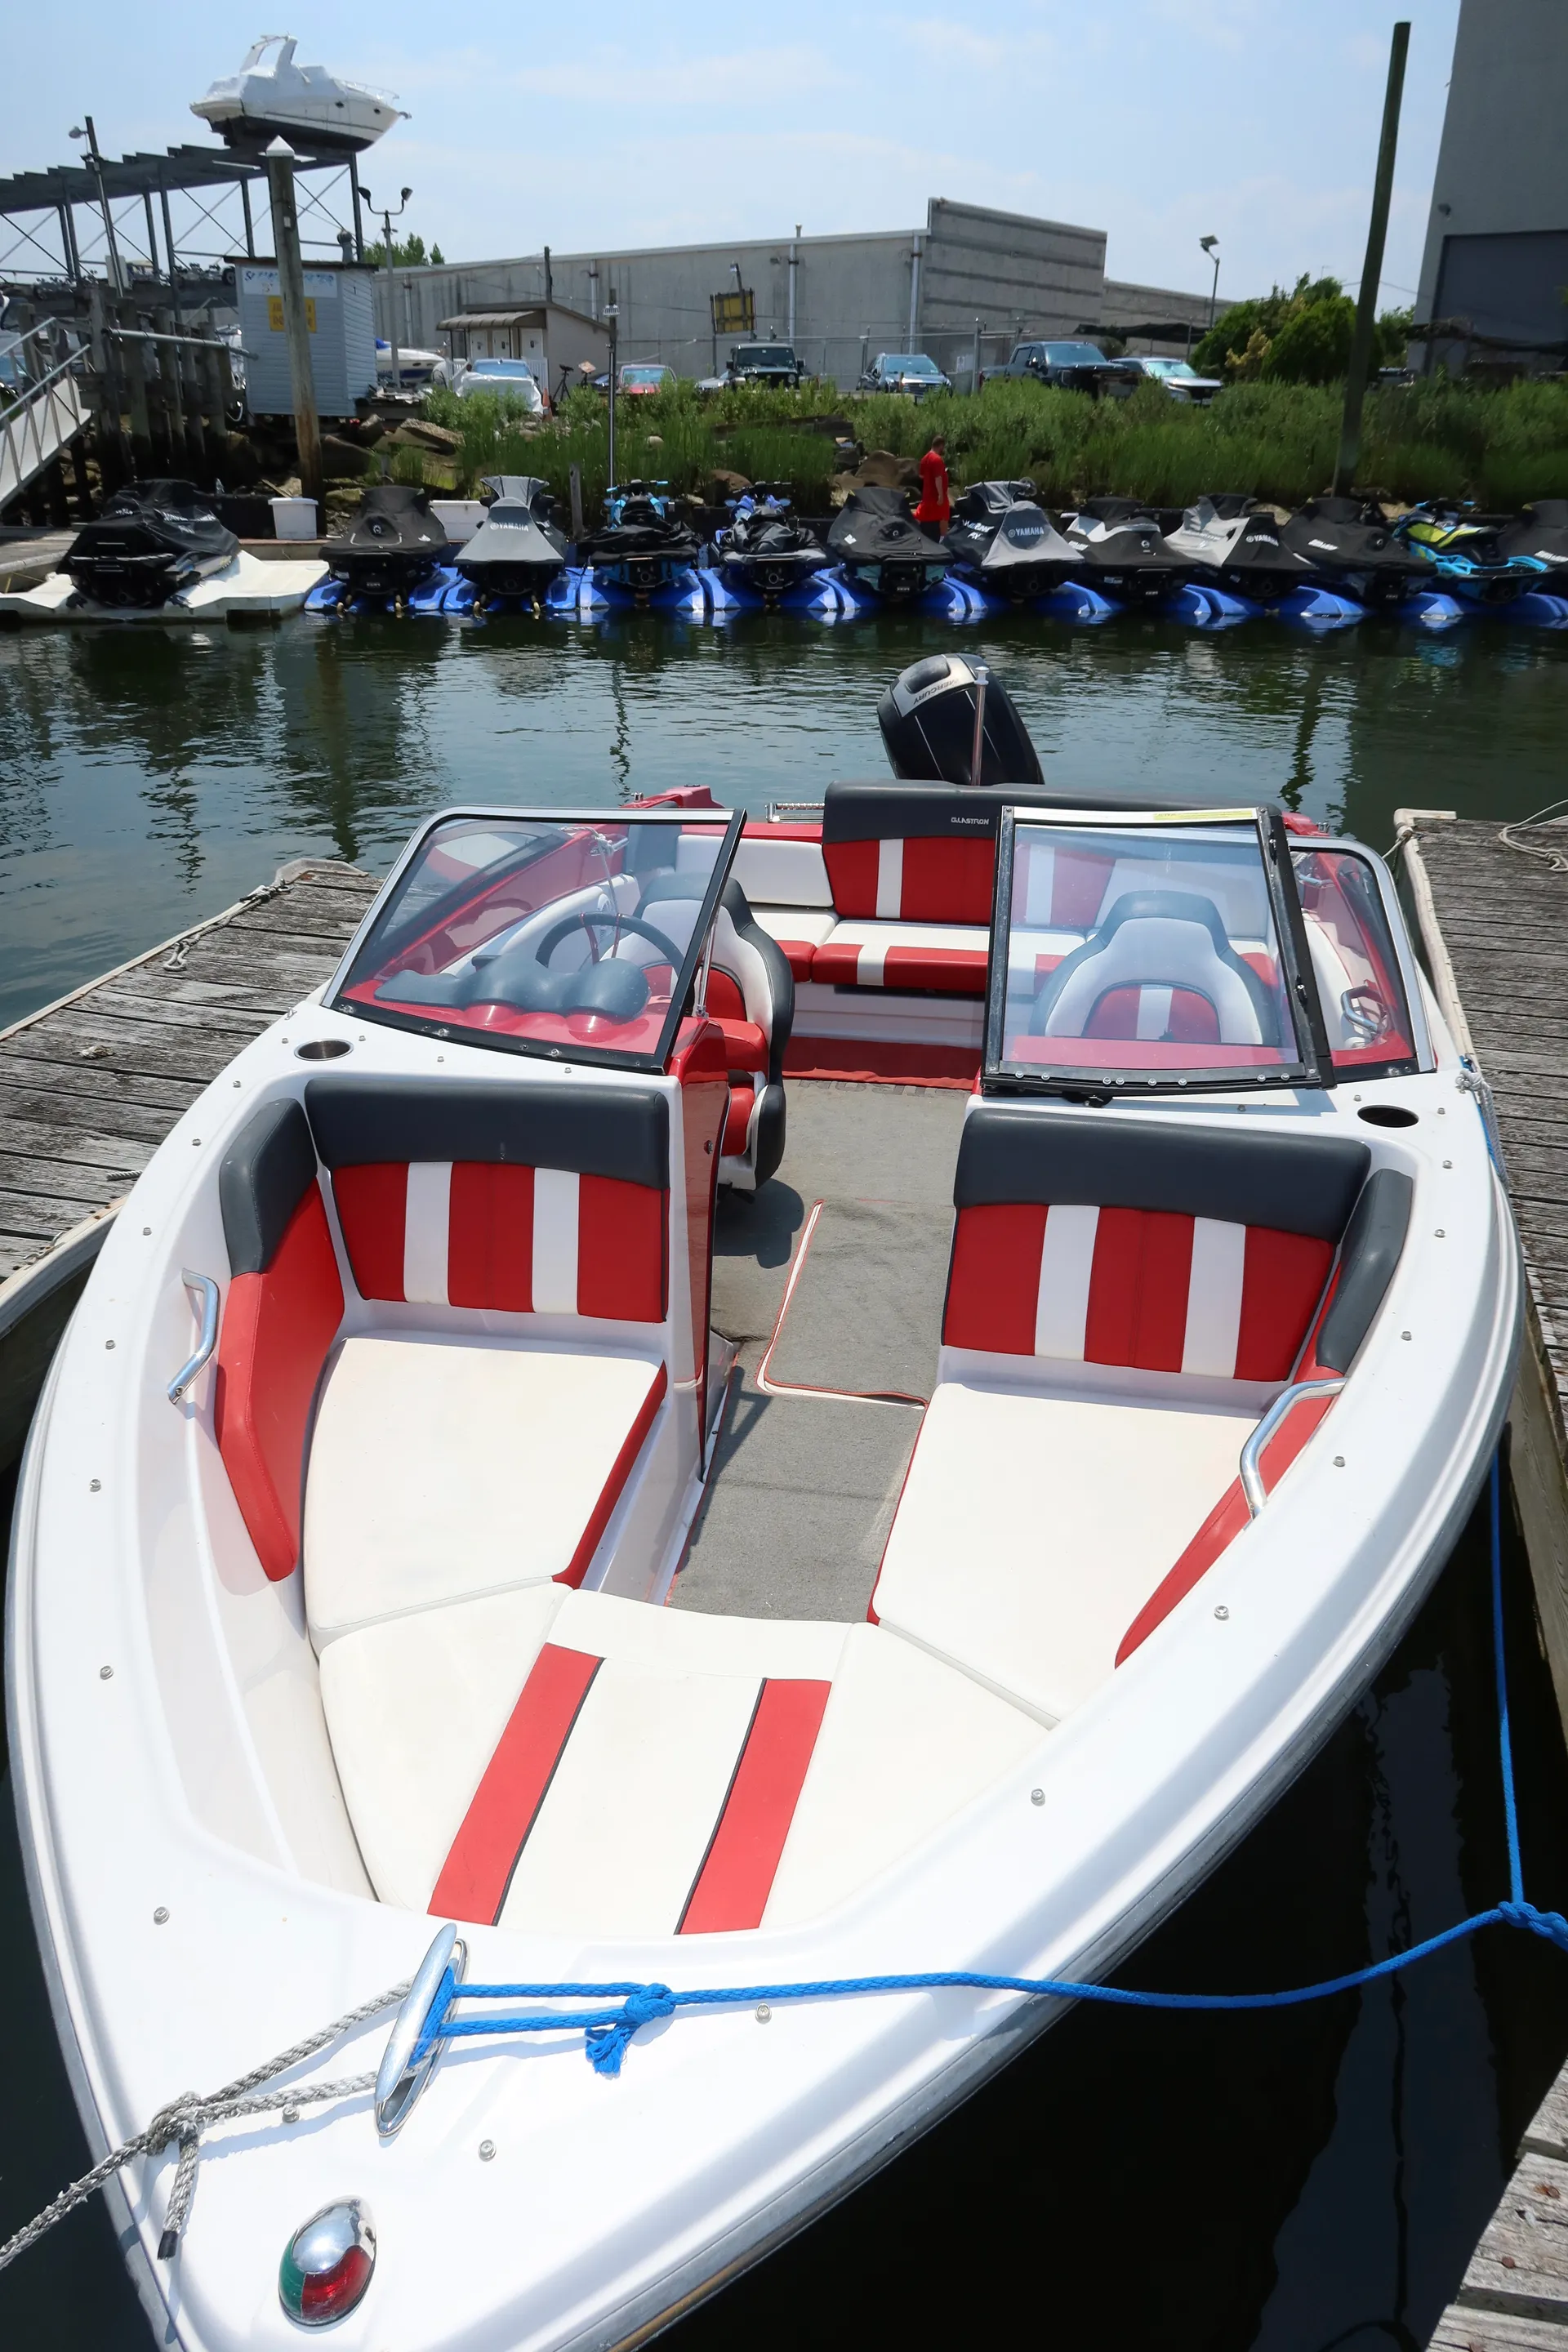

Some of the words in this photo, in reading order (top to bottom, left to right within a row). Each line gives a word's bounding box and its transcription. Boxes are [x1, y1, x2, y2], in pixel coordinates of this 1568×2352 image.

[499, 522, 529, 532] YAMAHA
[1015, 527, 1045, 537] YAMAHA
[1254, 534, 1279, 547] YAMAHA
[913, 679, 960, 705] MERCURY
[951, 817, 990, 825] GLASTRON
